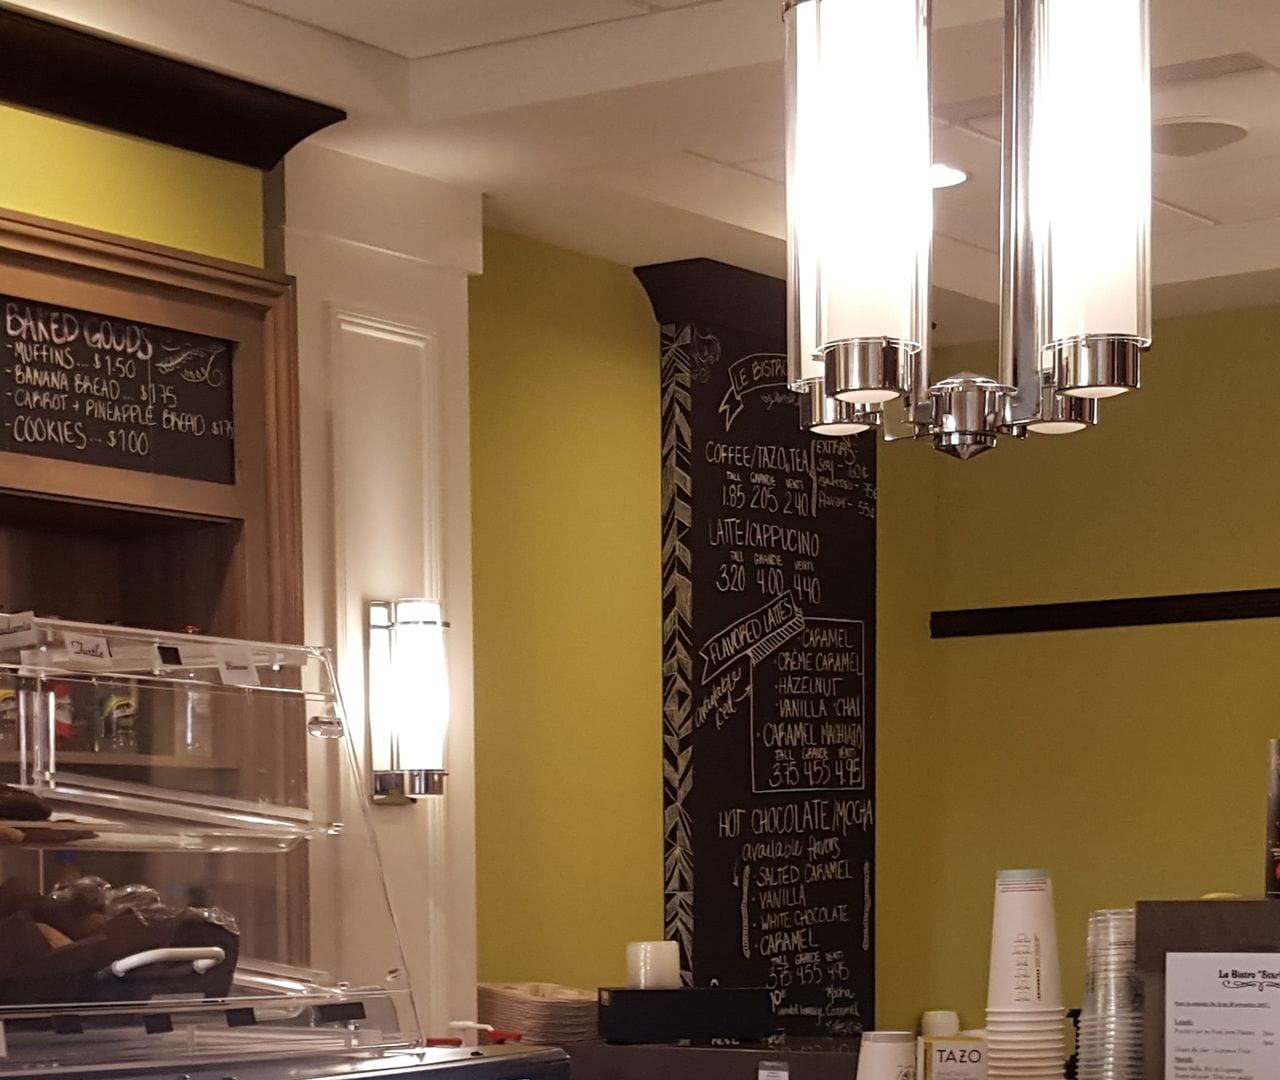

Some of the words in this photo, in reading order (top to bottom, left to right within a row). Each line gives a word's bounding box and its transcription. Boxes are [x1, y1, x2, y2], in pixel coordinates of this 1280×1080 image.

[5, 302, 80, 345] BAKED
[83, 318, 154, 361] GOODS
[752, 358, 788, 382] BISTR
[74, 374, 120, 400] BREAD
[85, 398, 157, 426] PINEAPPLE
[162, 410, 206, 437] BREAD
[789, 447, 810, 473] TEA
[778, 675, 843, 697] HAZELNUT
[719, 808, 747, 838] HOT
[759, 883, 807, 910] VANILLA
[759, 928, 820, 956] CARAMEL
[936, 1049, 982, 1064] TAZO
